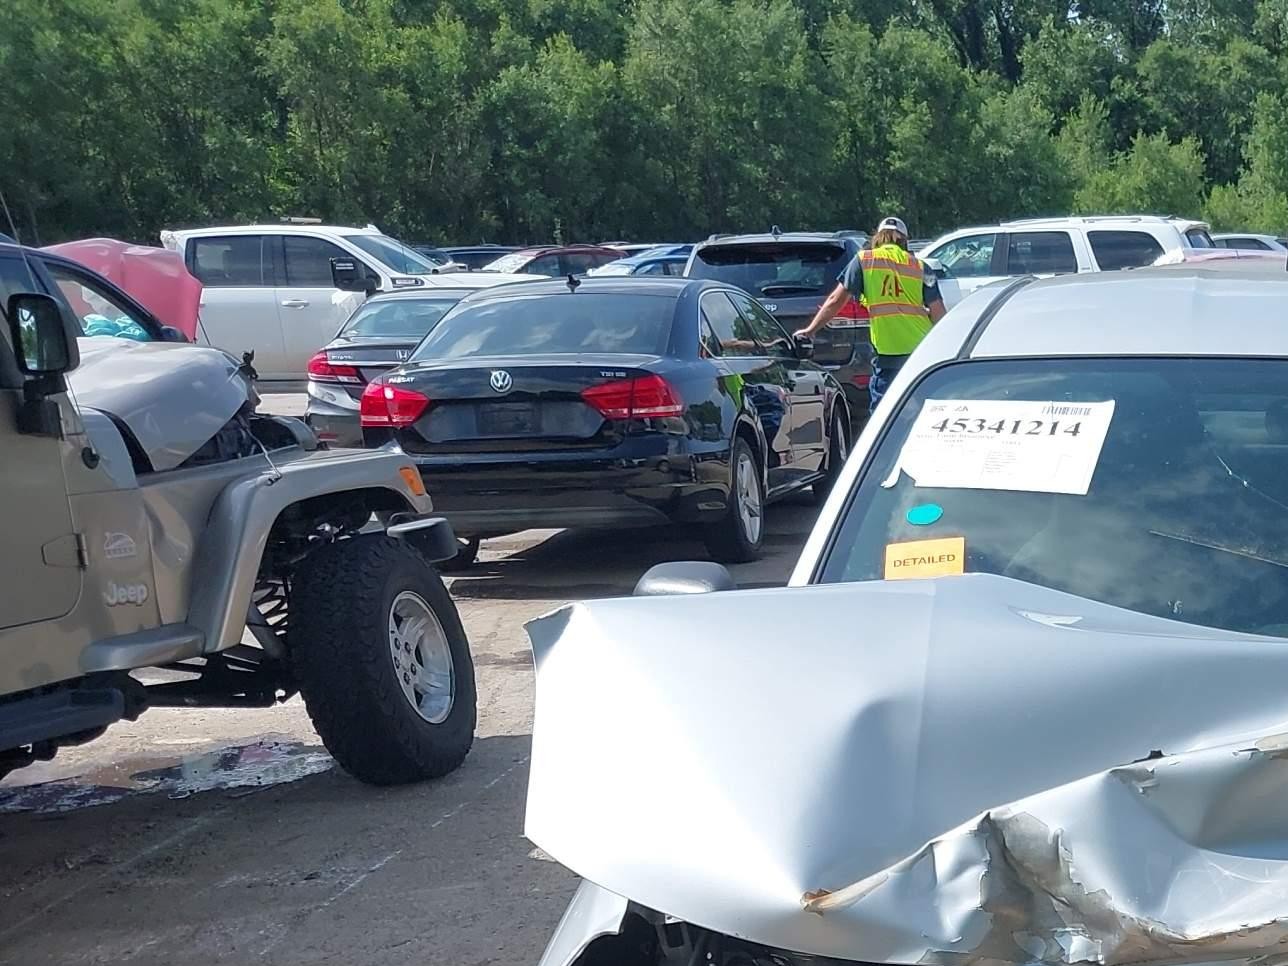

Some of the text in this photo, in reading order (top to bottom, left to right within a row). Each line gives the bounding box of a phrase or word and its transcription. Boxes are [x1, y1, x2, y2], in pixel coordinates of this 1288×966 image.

[931, 417, 1082, 437] 45341214
[893, 554, 956, 568] DETAILED
[103, 581, 149, 606] Jeep
